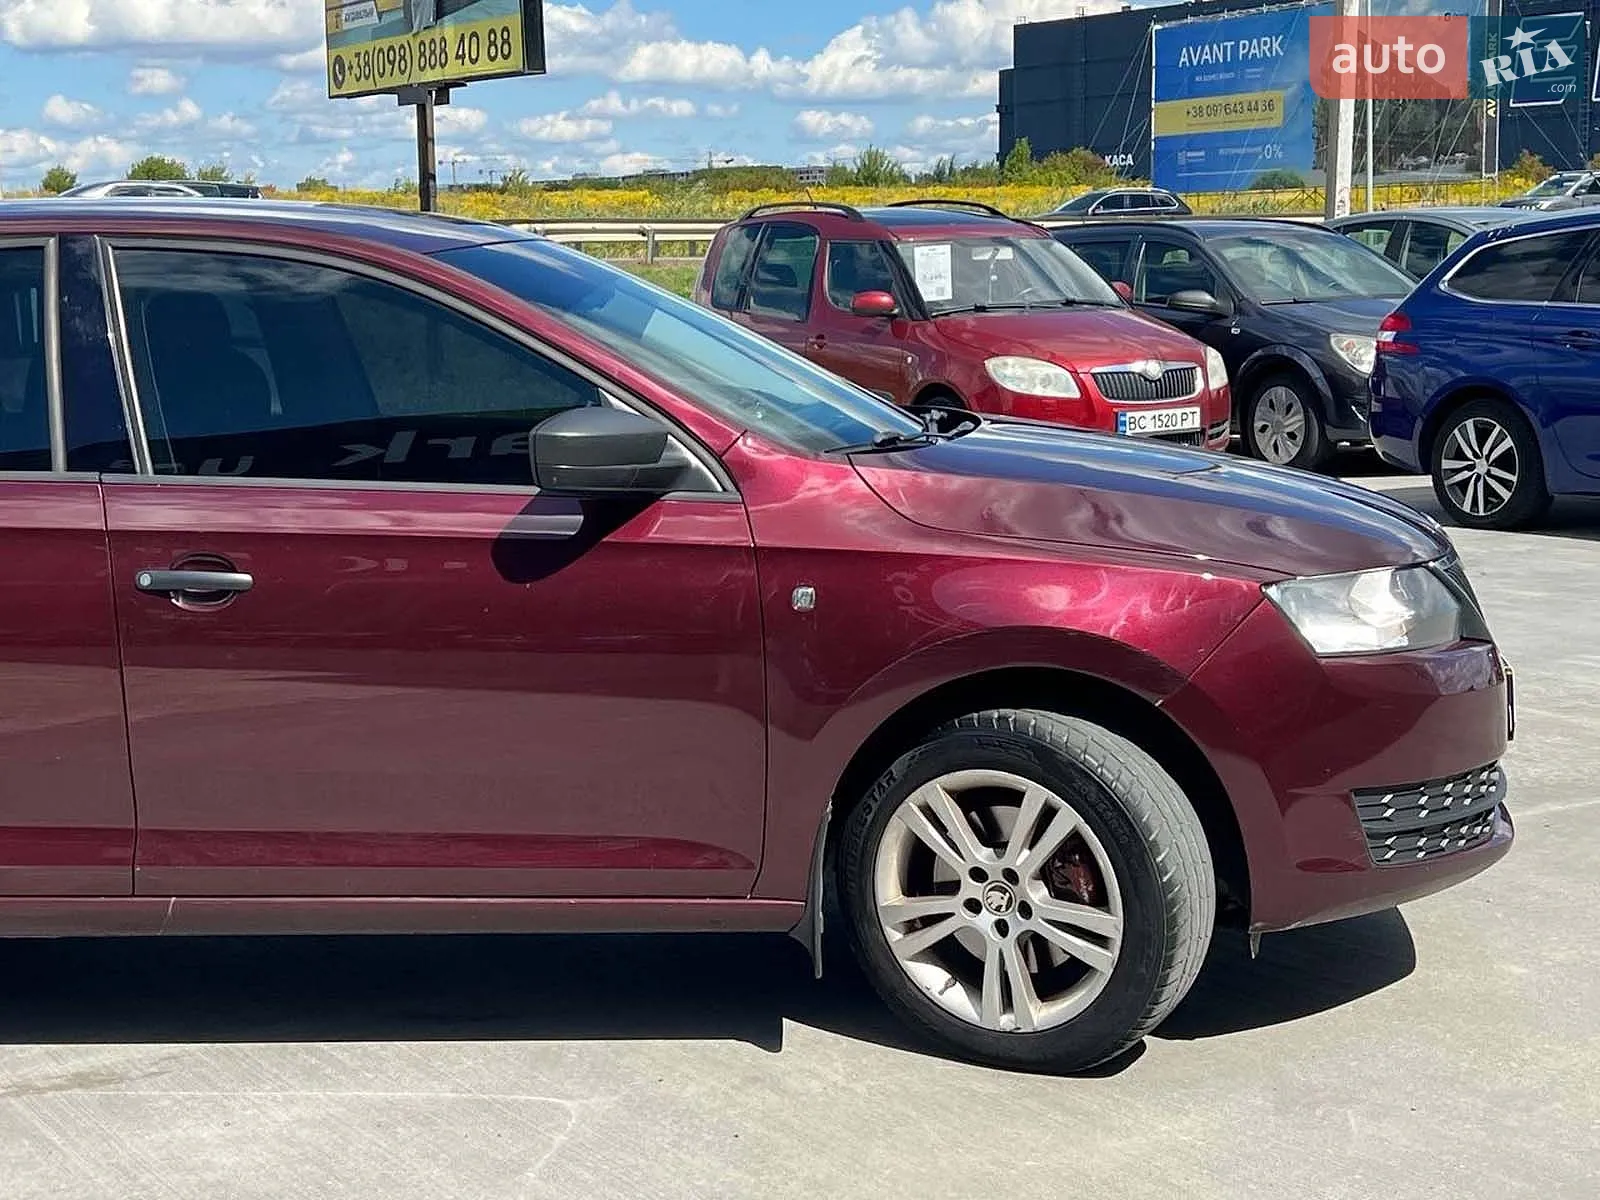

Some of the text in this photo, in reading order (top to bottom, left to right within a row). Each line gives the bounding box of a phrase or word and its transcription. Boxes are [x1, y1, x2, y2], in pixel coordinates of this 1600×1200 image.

[347, 26, 512, 87] +38(098) 888 40 88
[1178, 35, 1284, 67] AVANT PARK
[1186, 106, 1204, 118] +38
[1247, 100, 1259, 113] 44
[1263, 144, 1283, 160] 0%
[1128, 411, 1197, 431] BC 1520 PT
